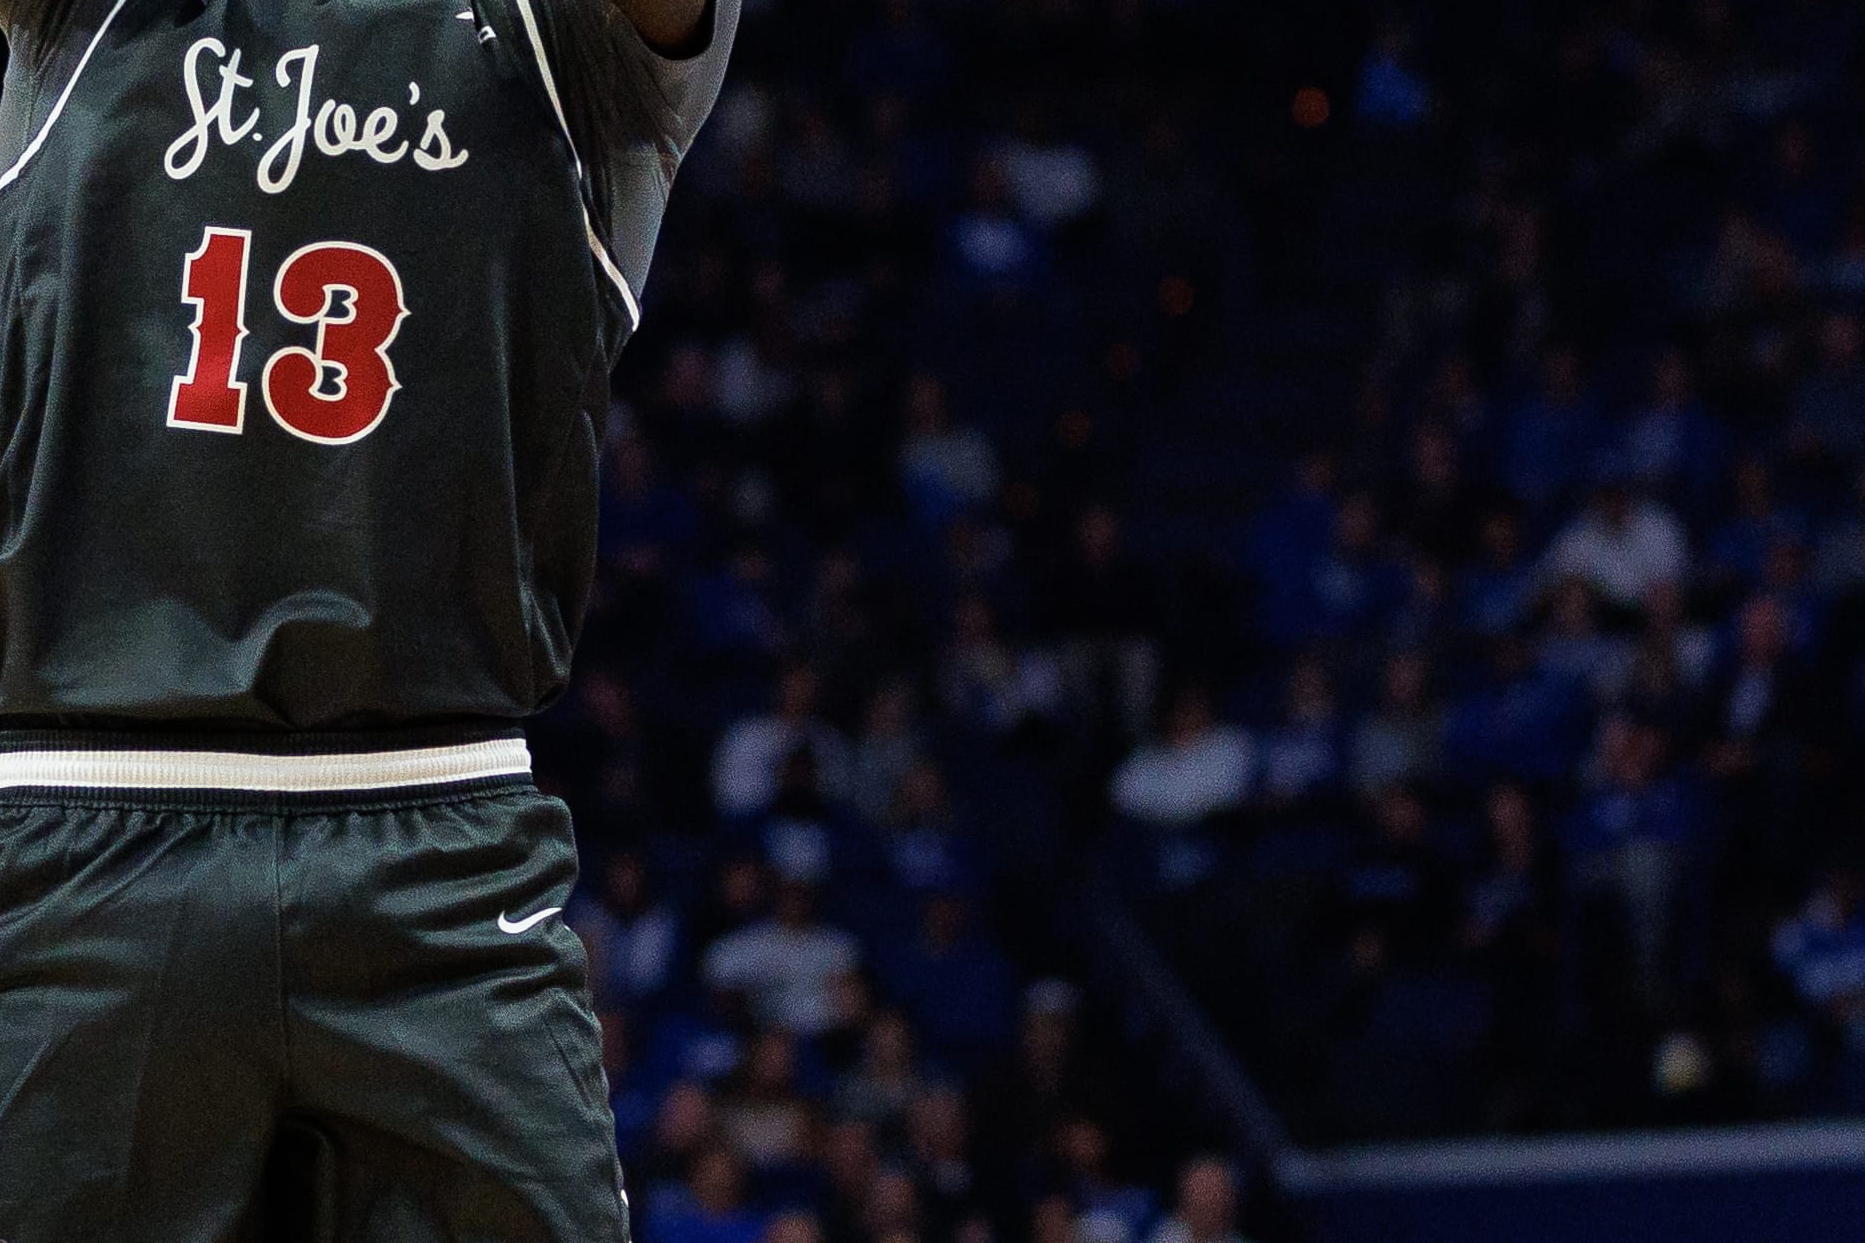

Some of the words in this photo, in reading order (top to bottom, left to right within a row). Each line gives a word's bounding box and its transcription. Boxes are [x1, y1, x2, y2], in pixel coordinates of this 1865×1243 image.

[164, 37, 263, 180] St.
[256, 43, 469, 194] Joe's
[166, 226, 412, 445] 13
